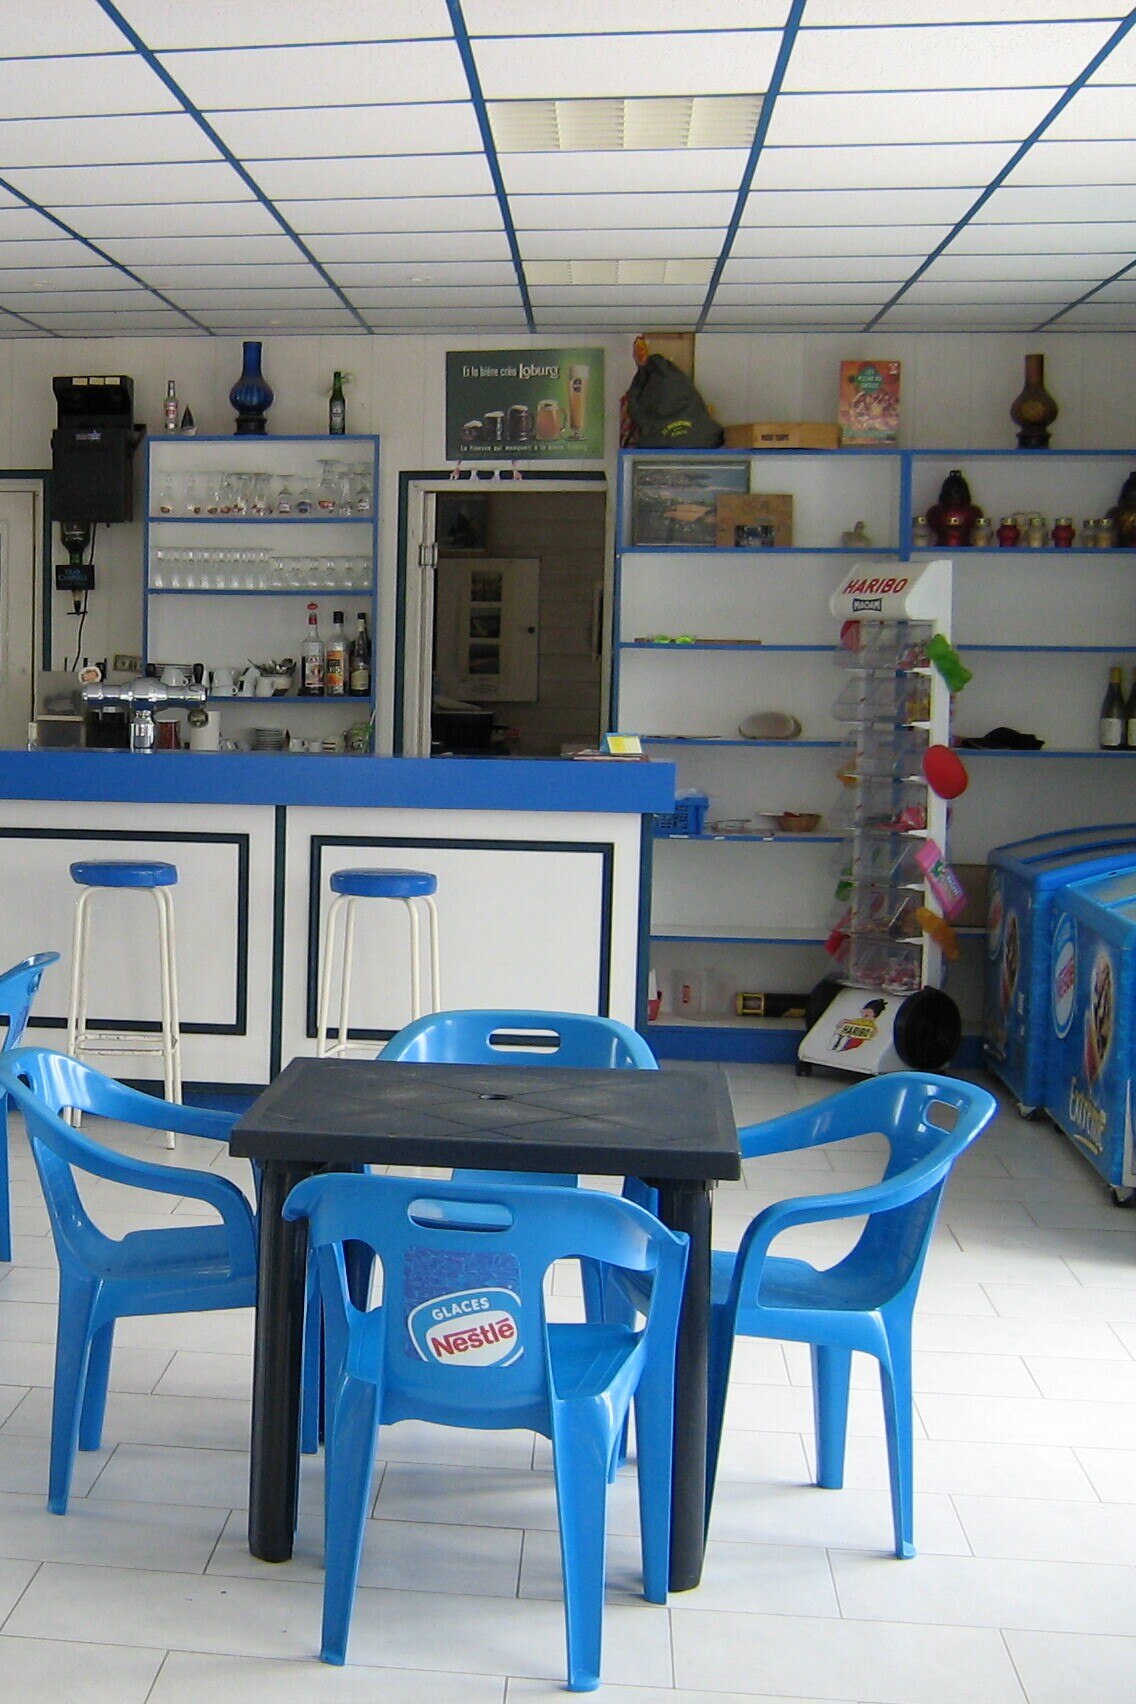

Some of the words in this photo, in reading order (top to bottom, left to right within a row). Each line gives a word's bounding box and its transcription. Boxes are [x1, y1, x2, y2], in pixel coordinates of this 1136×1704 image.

[519, 363, 559, 379] Loburg
[843, 578, 908, 594] HARIBO
[431, 1297, 491, 1321] GLACES
[430, 1317, 515, 1358] Nestlé
